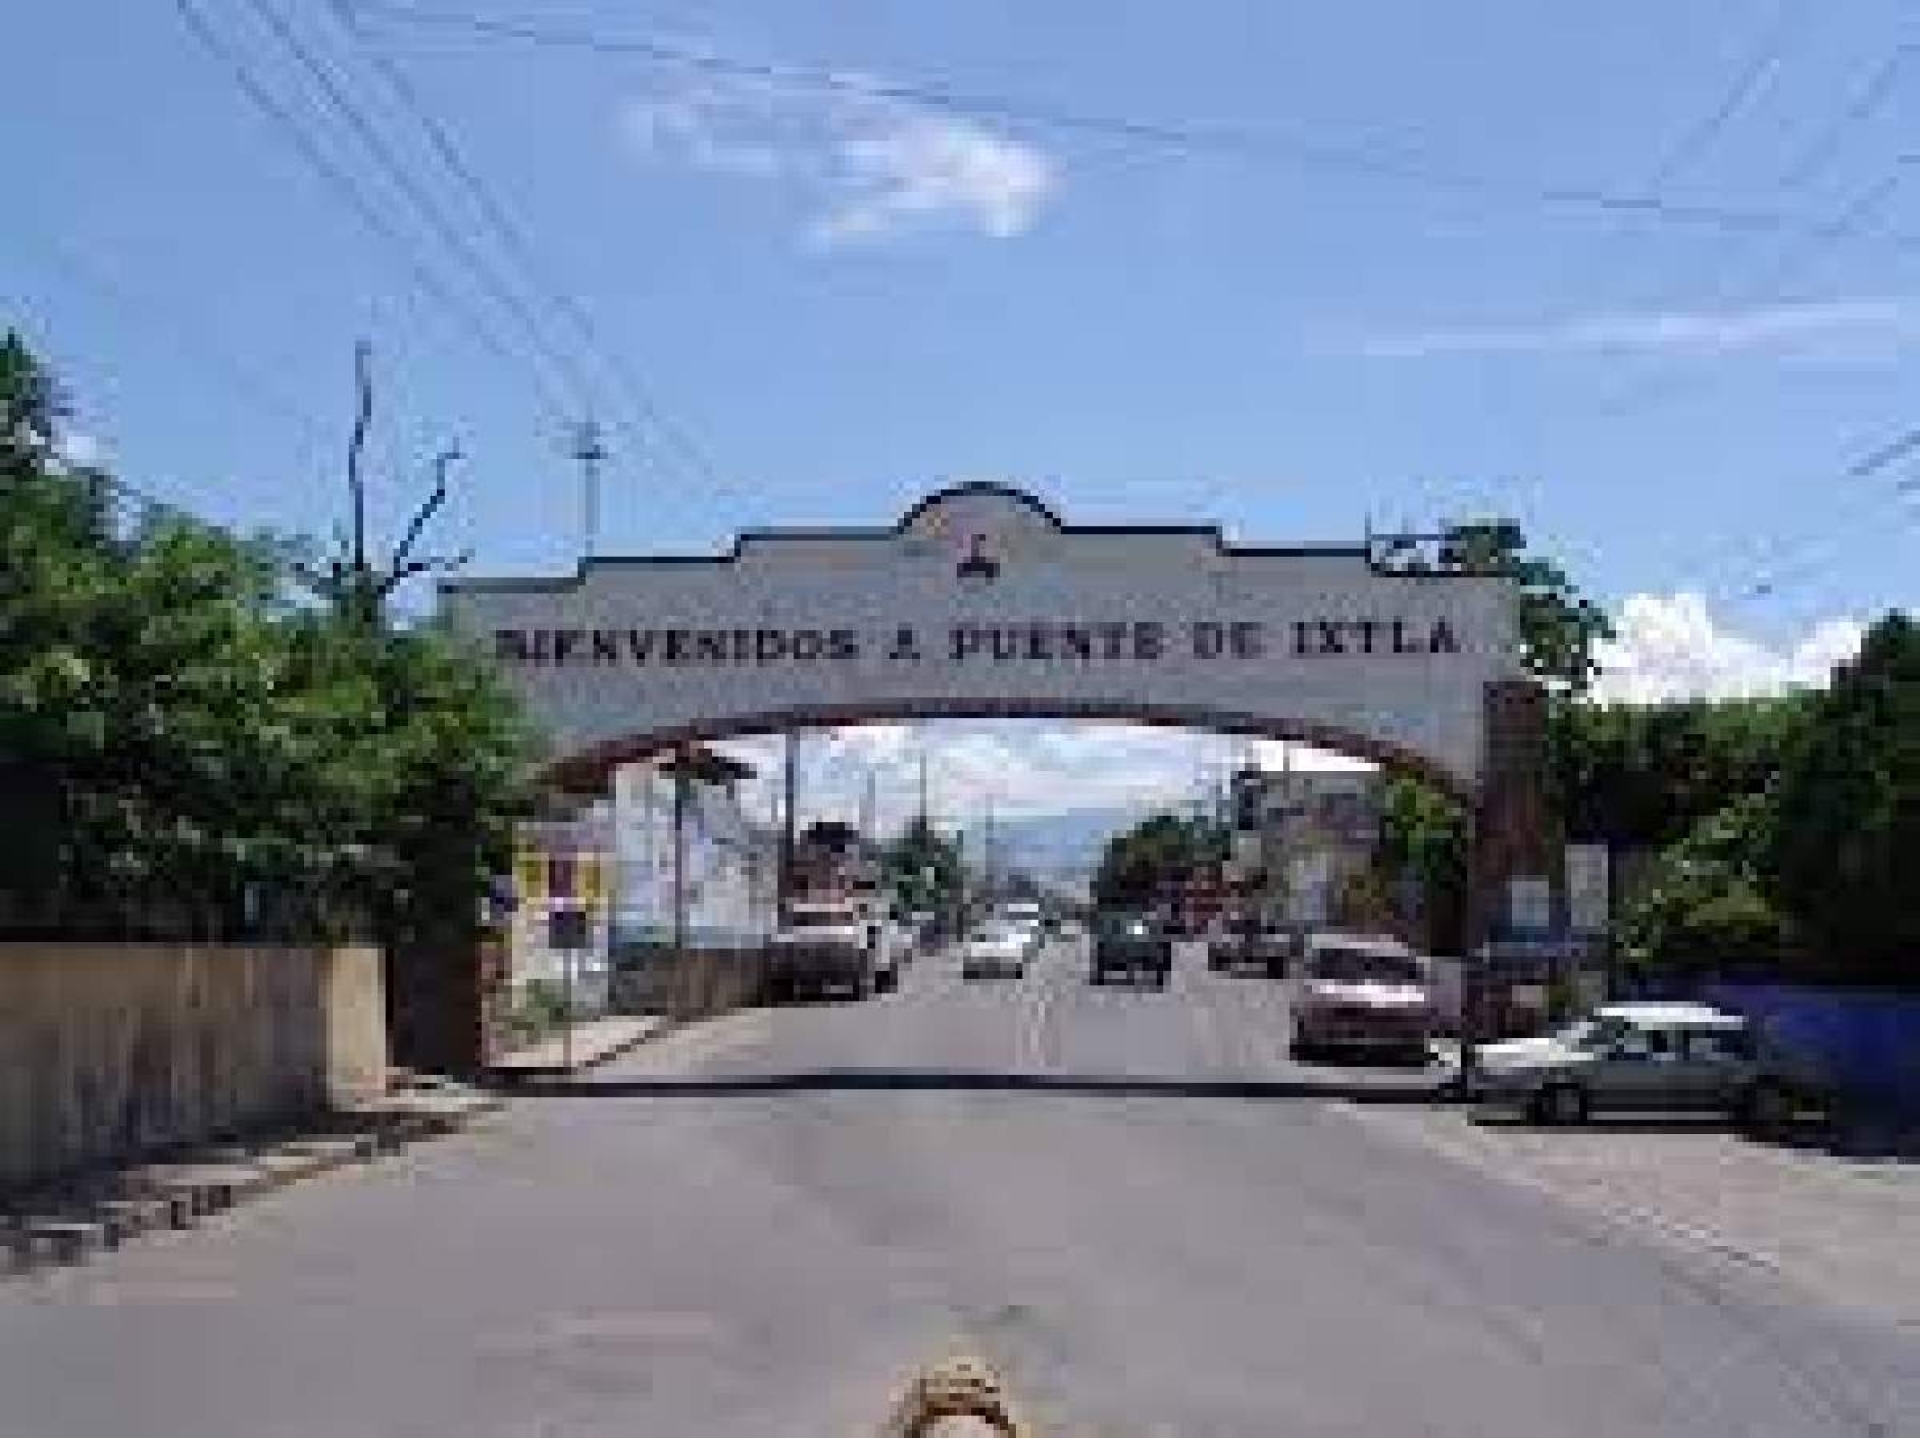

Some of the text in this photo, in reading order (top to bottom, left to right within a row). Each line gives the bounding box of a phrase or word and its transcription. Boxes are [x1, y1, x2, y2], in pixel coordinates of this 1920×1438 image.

[890, 624, 926, 662] A
[950, 622, 1163, 660] PUENTE
[1194, 621, 1262, 659] DE
[1293, 618, 1461, 655] IXTLA
